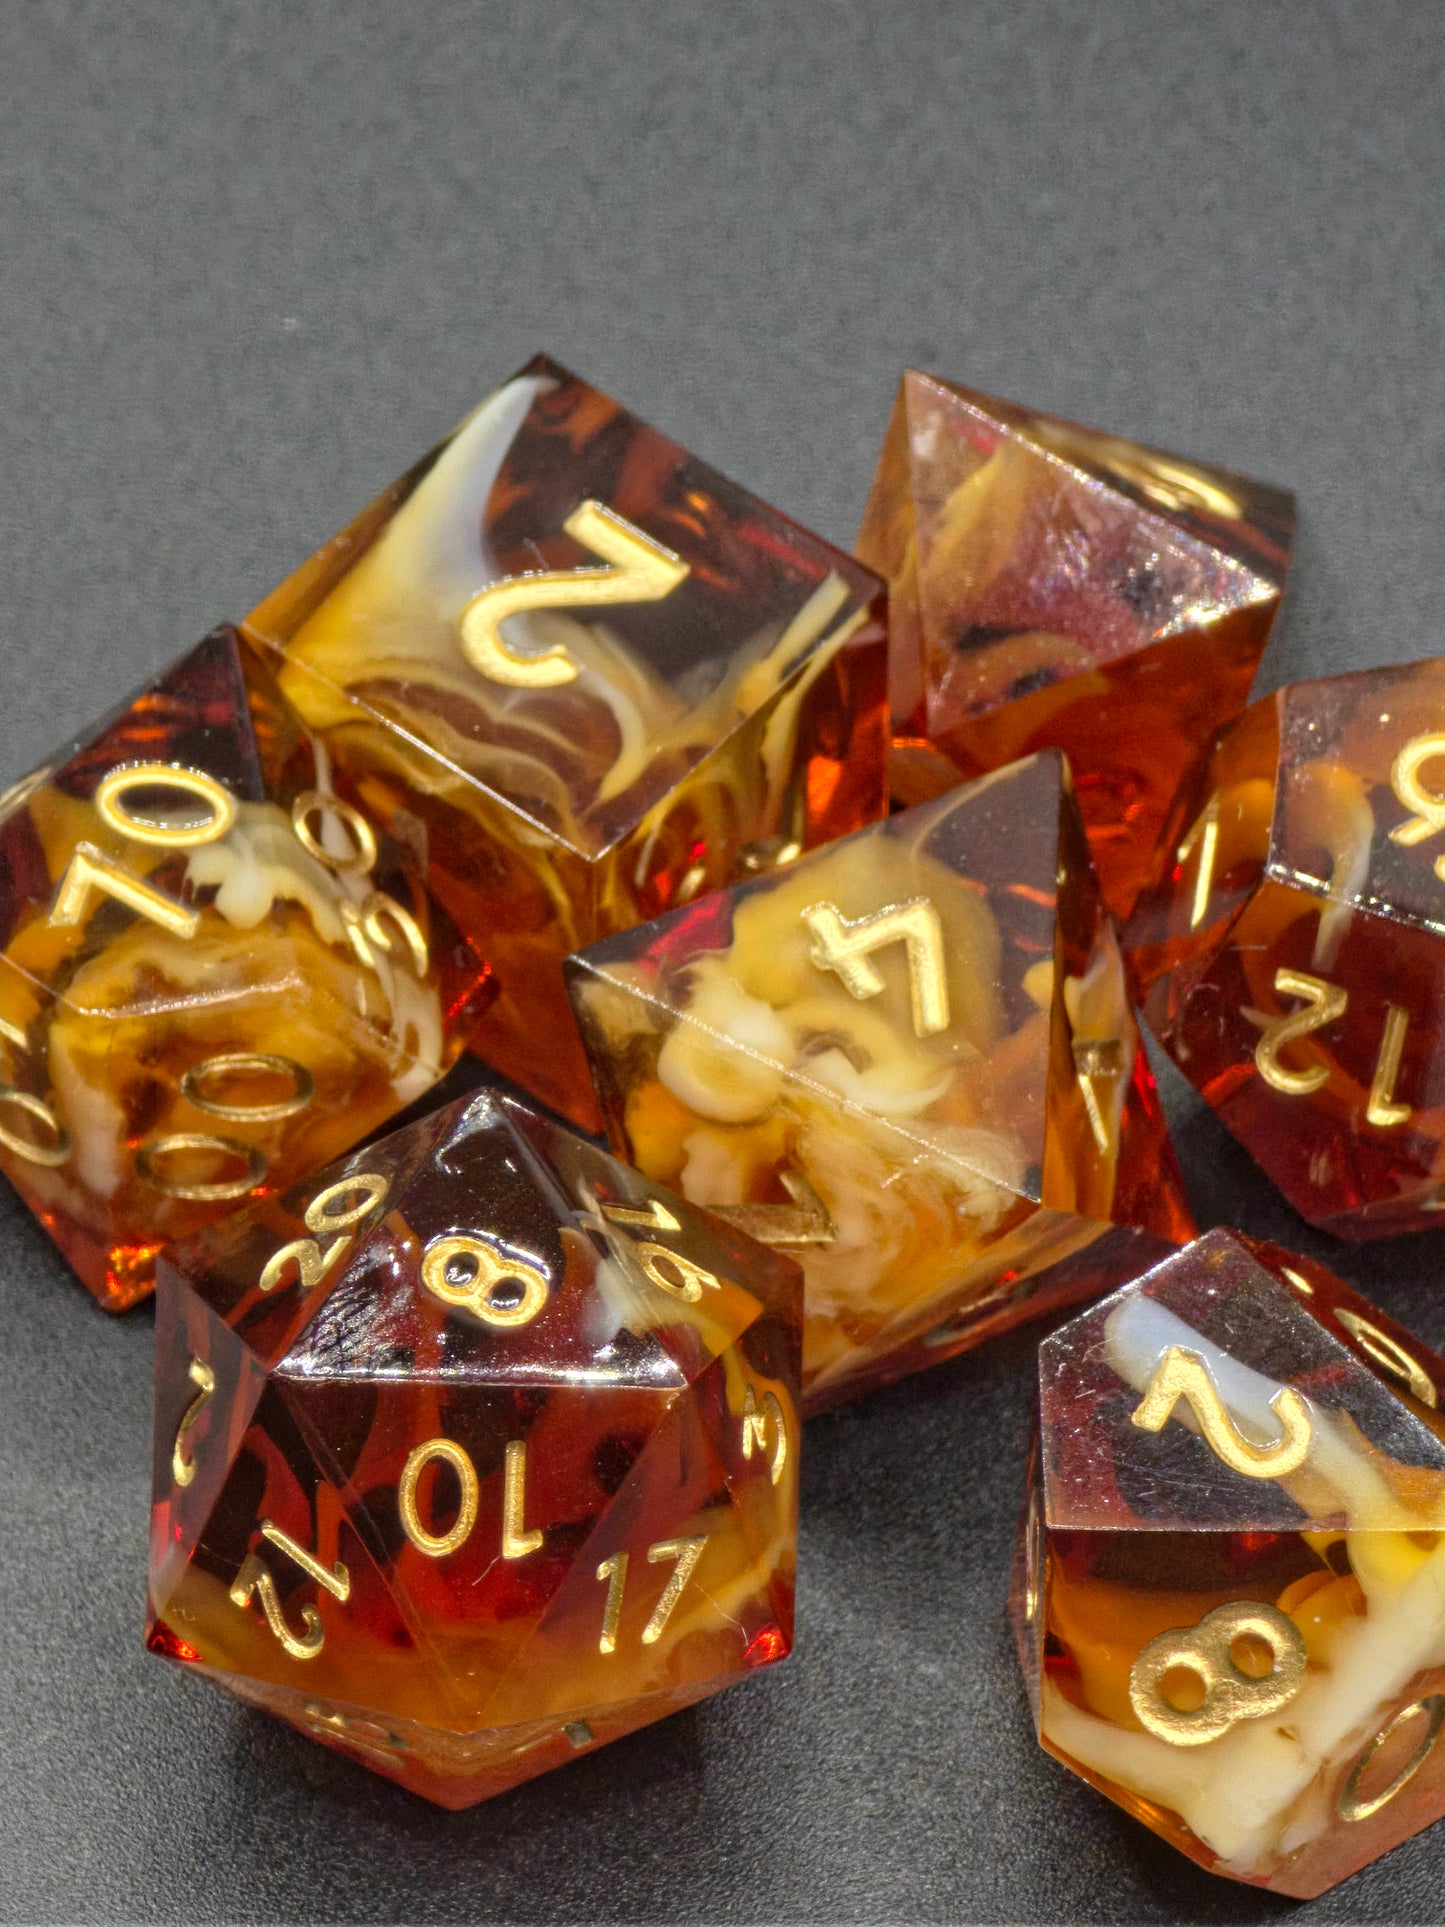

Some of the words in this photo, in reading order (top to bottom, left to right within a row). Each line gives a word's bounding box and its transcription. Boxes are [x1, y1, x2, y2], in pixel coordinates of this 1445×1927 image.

[460, 498, 690, 688] 2
[48, 761, 236, 939] 70
[800, 896, 951, 1038] 4
[1255, 967, 1413, 1127] 12
[258, 1172, 389, 1293] 20
[421, 1228, 552, 1327] 8
[1130, 1344, 1313, 1479] 2
[398, 1438, 545, 1559] 10
[229, 1518, 352, 1660] 12
[595, 1532, 709, 1654] 17
[1128, 1599, 1307, 1747] 8
